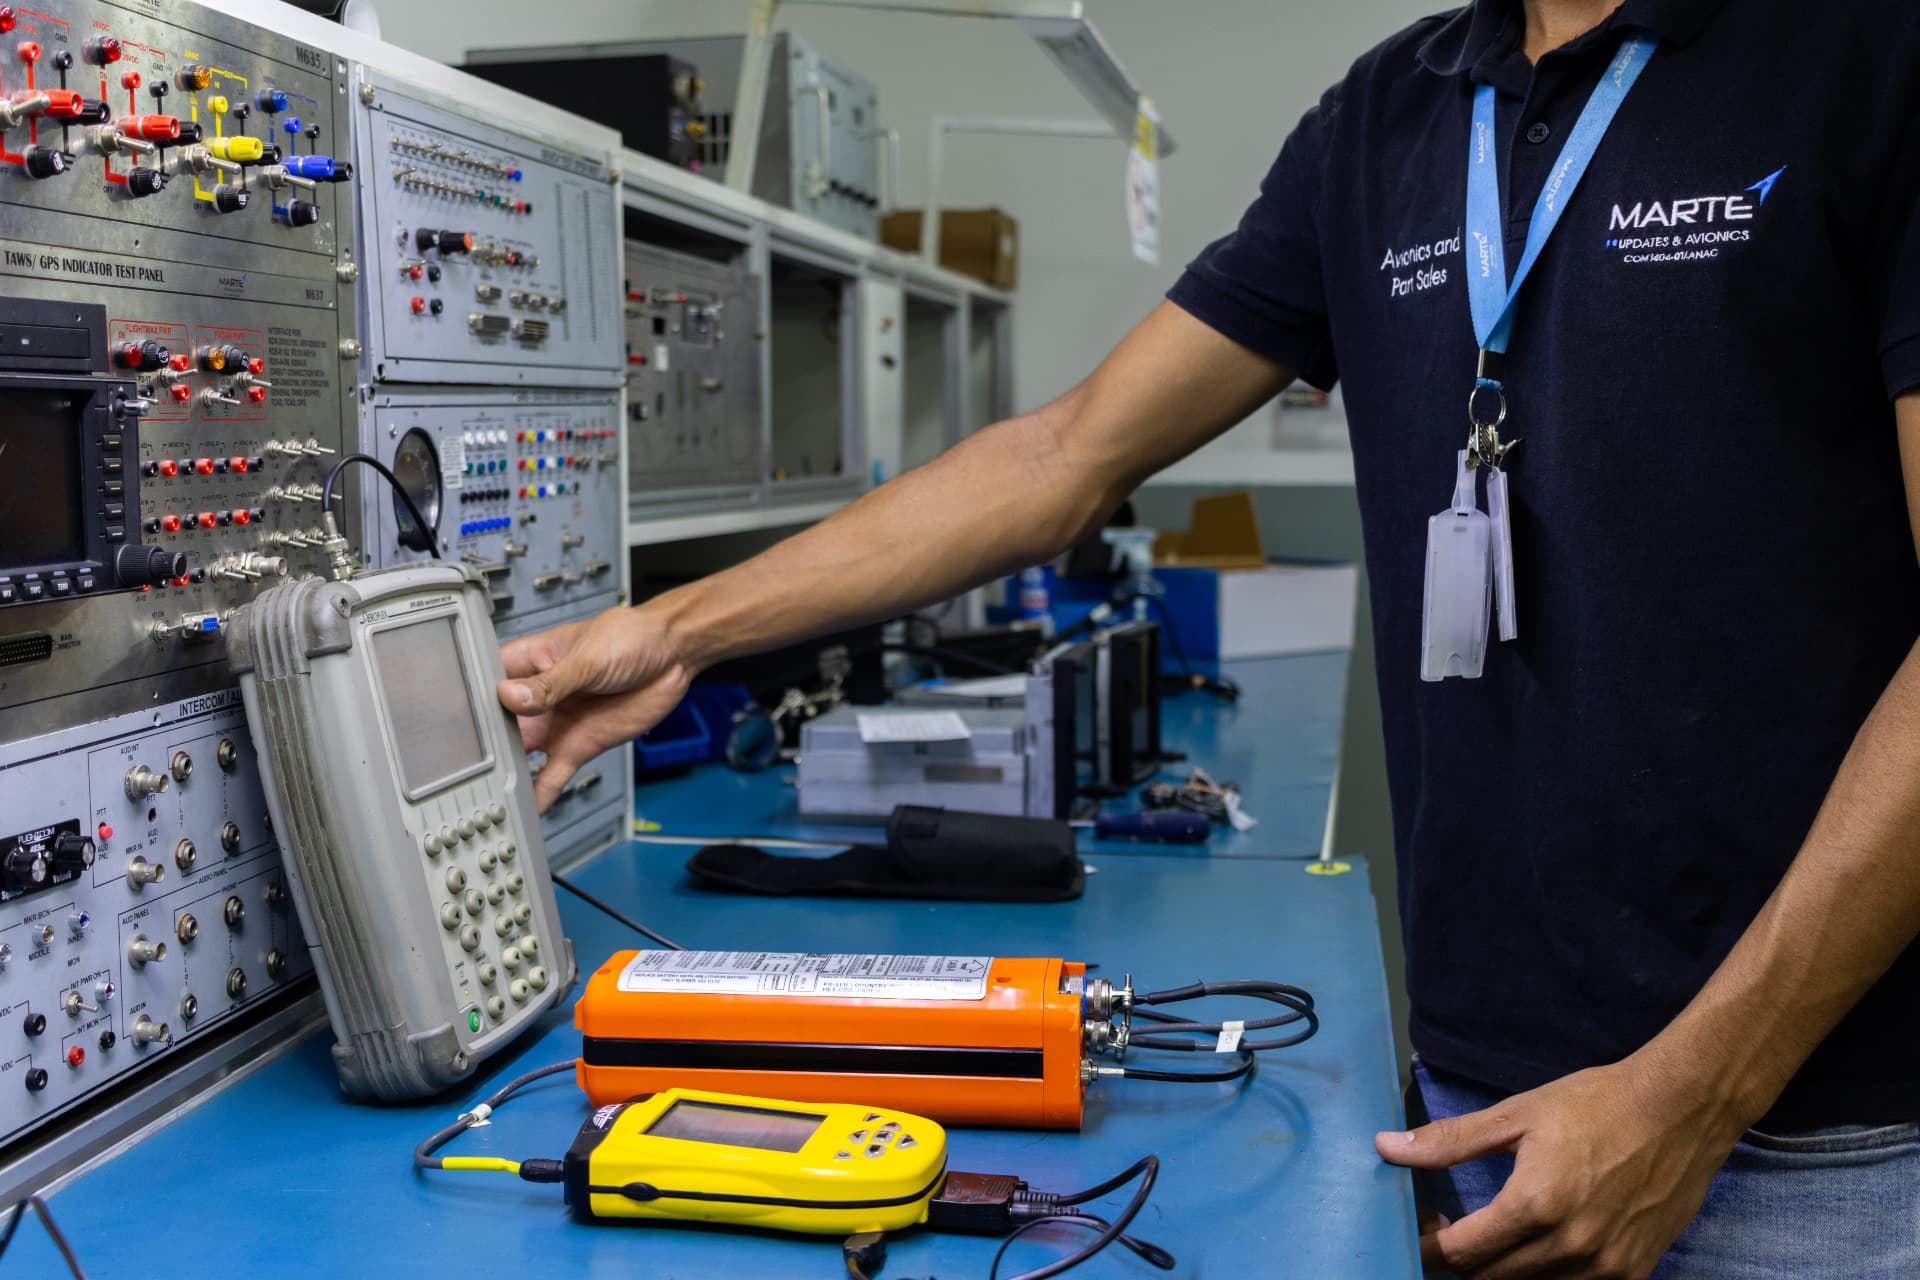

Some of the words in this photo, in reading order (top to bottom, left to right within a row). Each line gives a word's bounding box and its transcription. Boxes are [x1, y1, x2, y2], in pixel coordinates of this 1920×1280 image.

[55, 33, 68, 43] GND
[1609, 195, 1753, 231] MARTE
[1618, 236, 1669, 250] UPDATES
[1671, 233, 1682, 247] &
[1685, 230, 1750, 245] AVIONICS
[1380, 243, 1431, 271] Avionics
[1434, 226, 1460, 256] and
[1480, 235, 1490, 278] MARTE
[40, 255, 59, 271] GPS
[62, 258, 113, 277] INDICATOR
[114, 265, 137, 280] TEST
[138, 266, 166, 283] PANEL
[218, 277, 244, 288] MARTE
[1391, 274, 1414, 297] Part
[1416, 263, 1447, 291] Sales
[179, 693, 227, 717] INTERCOM
[96, 807, 107, 817] PTT
[148, 828, 159, 839] AUD
[137, 843, 143, 851] IN
[149, 837, 158, 847] INT
[23, 912, 37, 925] MKR
[122, 915, 133, 925] AUD
[67, 933, 85, 946] INNER
[28, 949, 51, 962] MIDDLE
[67, 956, 81, 968] MON
[70, 981, 80, 992] INT
[80, 974, 94, 987] PWR
[130, 1004, 140, 1015] AUD
[140, 1002, 147, 1011] IN
[76, 1024, 87, 1035] INT
[86, 1017, 99, 1031] MON
[1, 1060, 14, 1073] VDC
